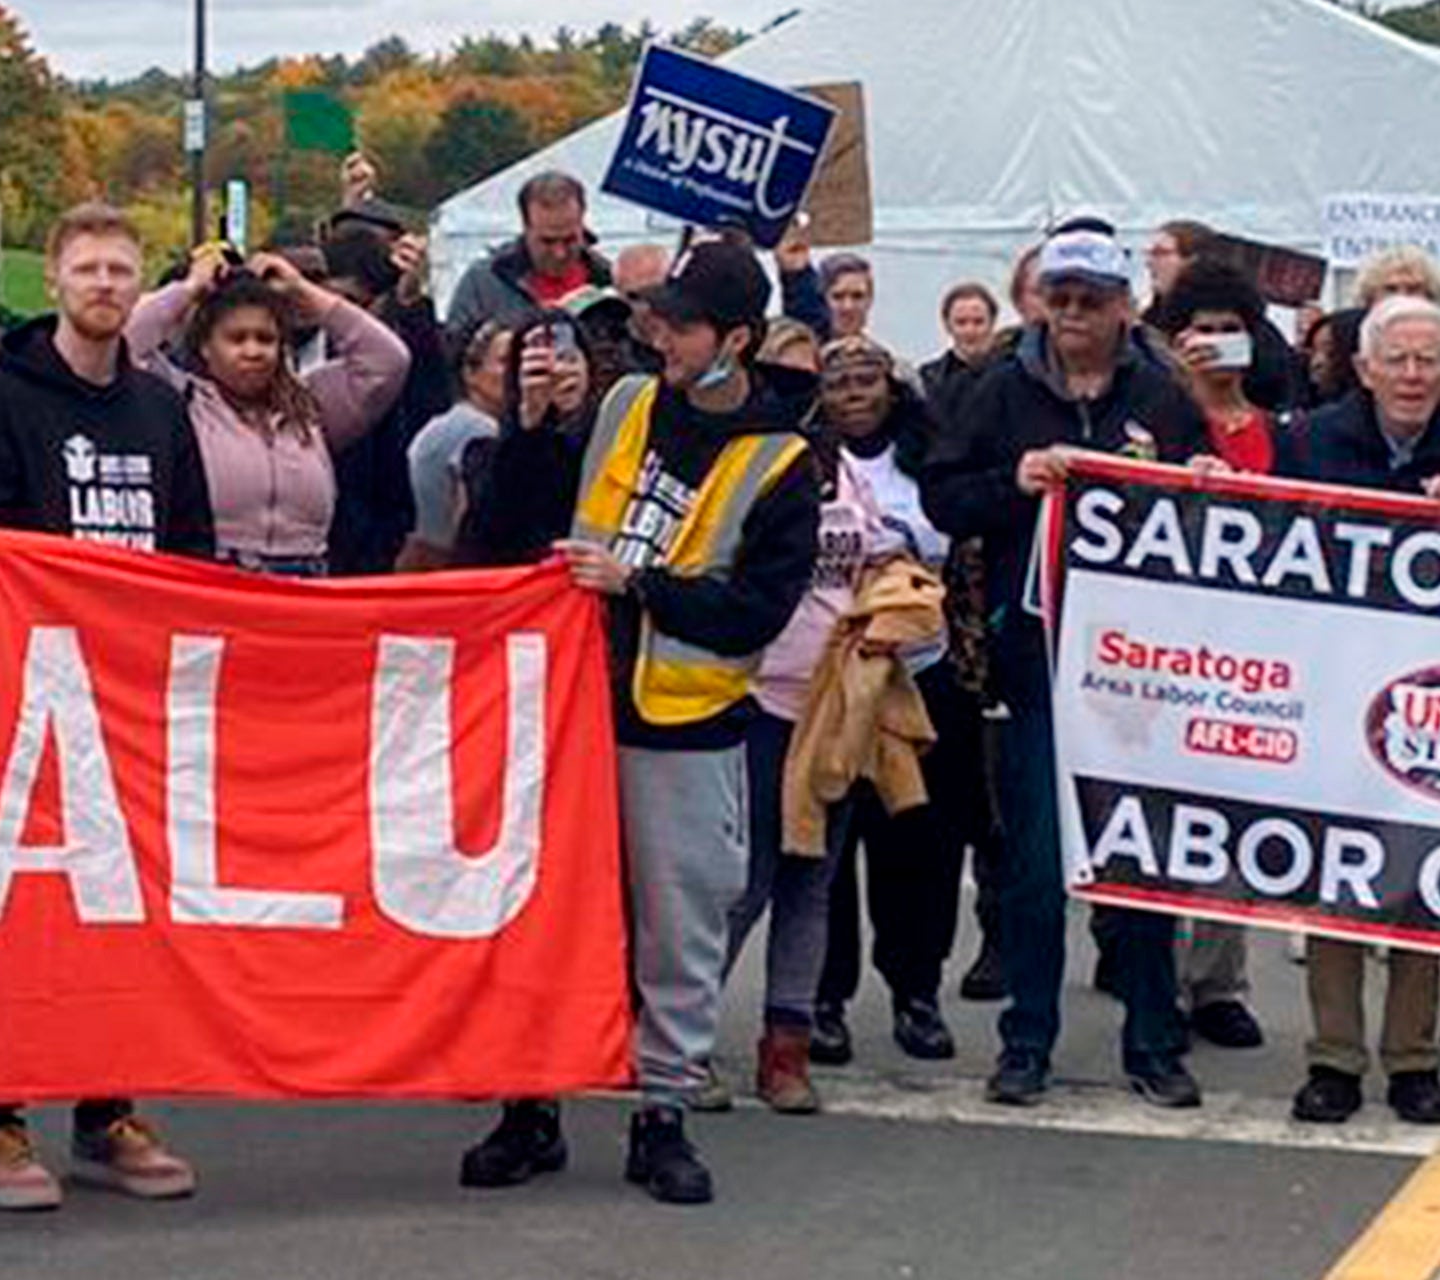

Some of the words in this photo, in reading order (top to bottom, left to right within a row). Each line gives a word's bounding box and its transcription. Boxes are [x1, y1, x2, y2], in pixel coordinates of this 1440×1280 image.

[636, 99, 802, 219] nysut
[69, 485, 155, 527] LABOR
[1098, 630, 1290, 693] Saratoga
[1080, 672, 1133, 696] Area
[1141, 681, 1208, 707] Labor
[1215, 690, 1302, 721] Council
[1189, 721, 1294, 758] AFL-CIO
[1091, 795, 1386, 909] ABOR
